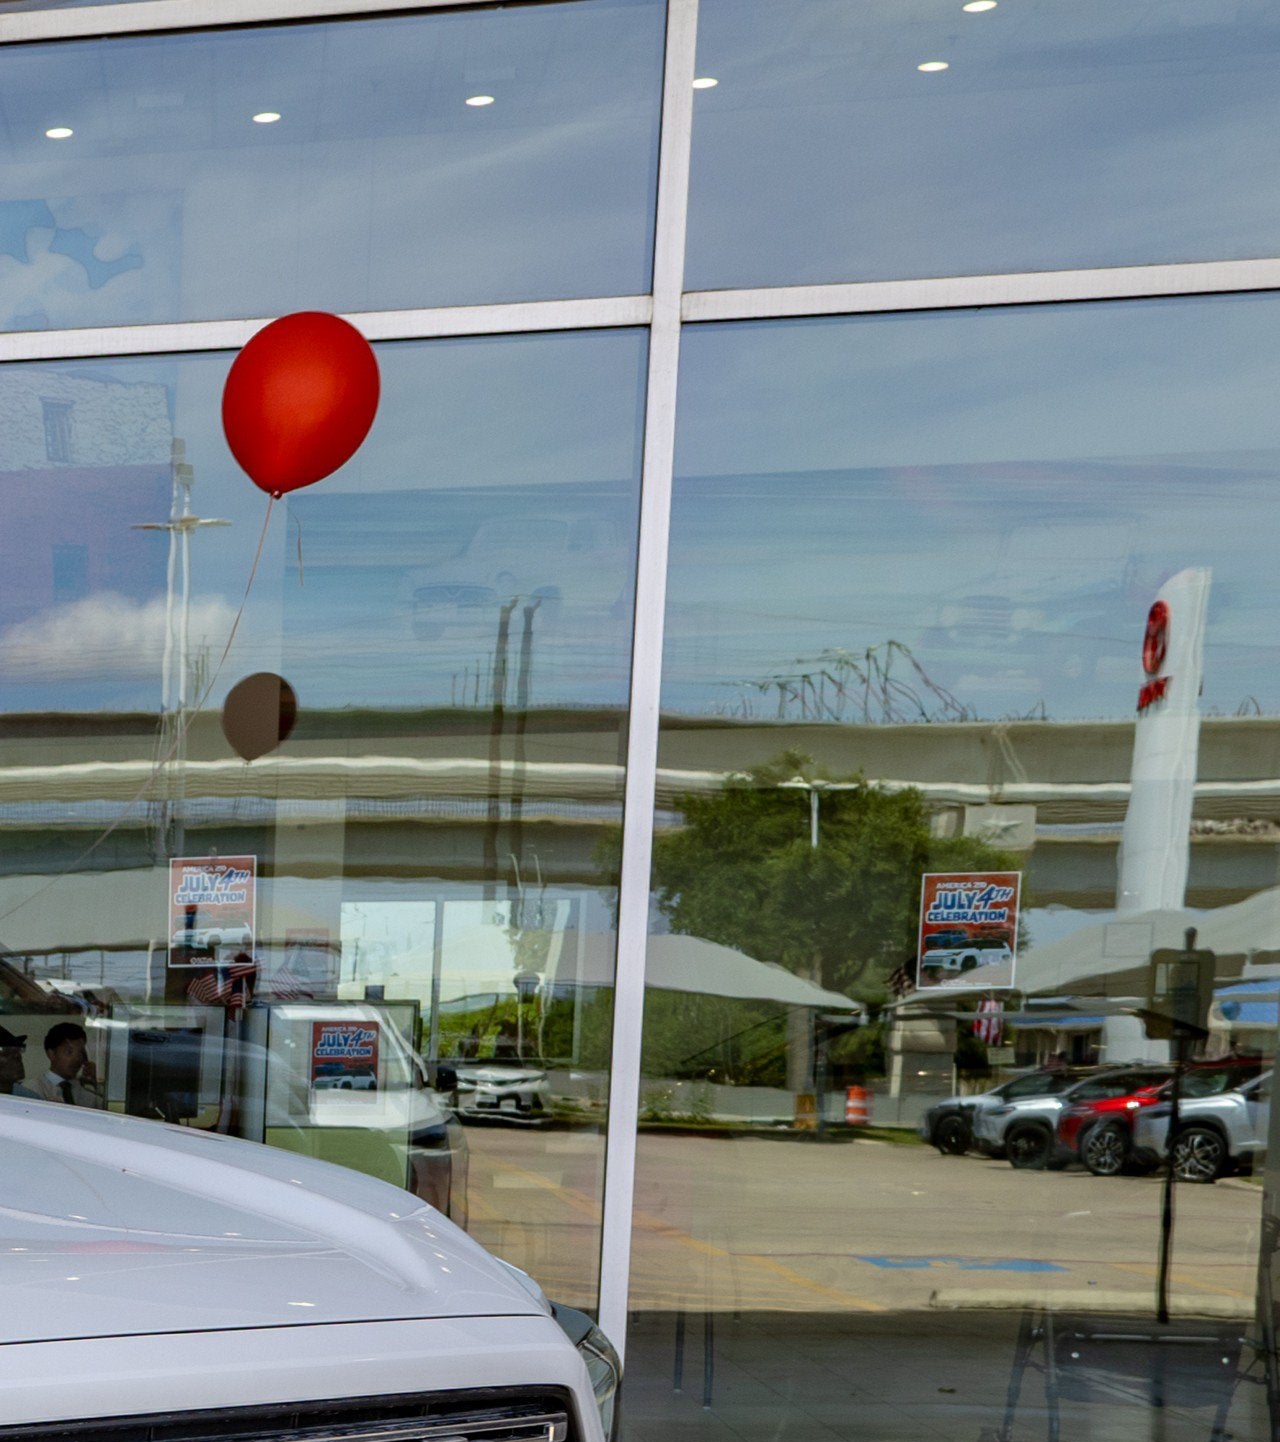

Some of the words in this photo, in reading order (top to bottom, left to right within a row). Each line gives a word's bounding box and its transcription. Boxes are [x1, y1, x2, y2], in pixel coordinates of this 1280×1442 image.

[179, 873, 220, 893] JULY
[219, 868, 250, 892] 4TH
[175, 890, 246, 904] CELEBRATION
[931, 889, 978, 910] JULY
[976, 885, 1012, 910] 4TH
[927, 908, 1006, 923] CELEBRATION
[319, 1032, 350, 1047] JULY
[350, 1029, 375, 1047] 4TH
[315, 1046, 372, 1057] CELEBRATION
